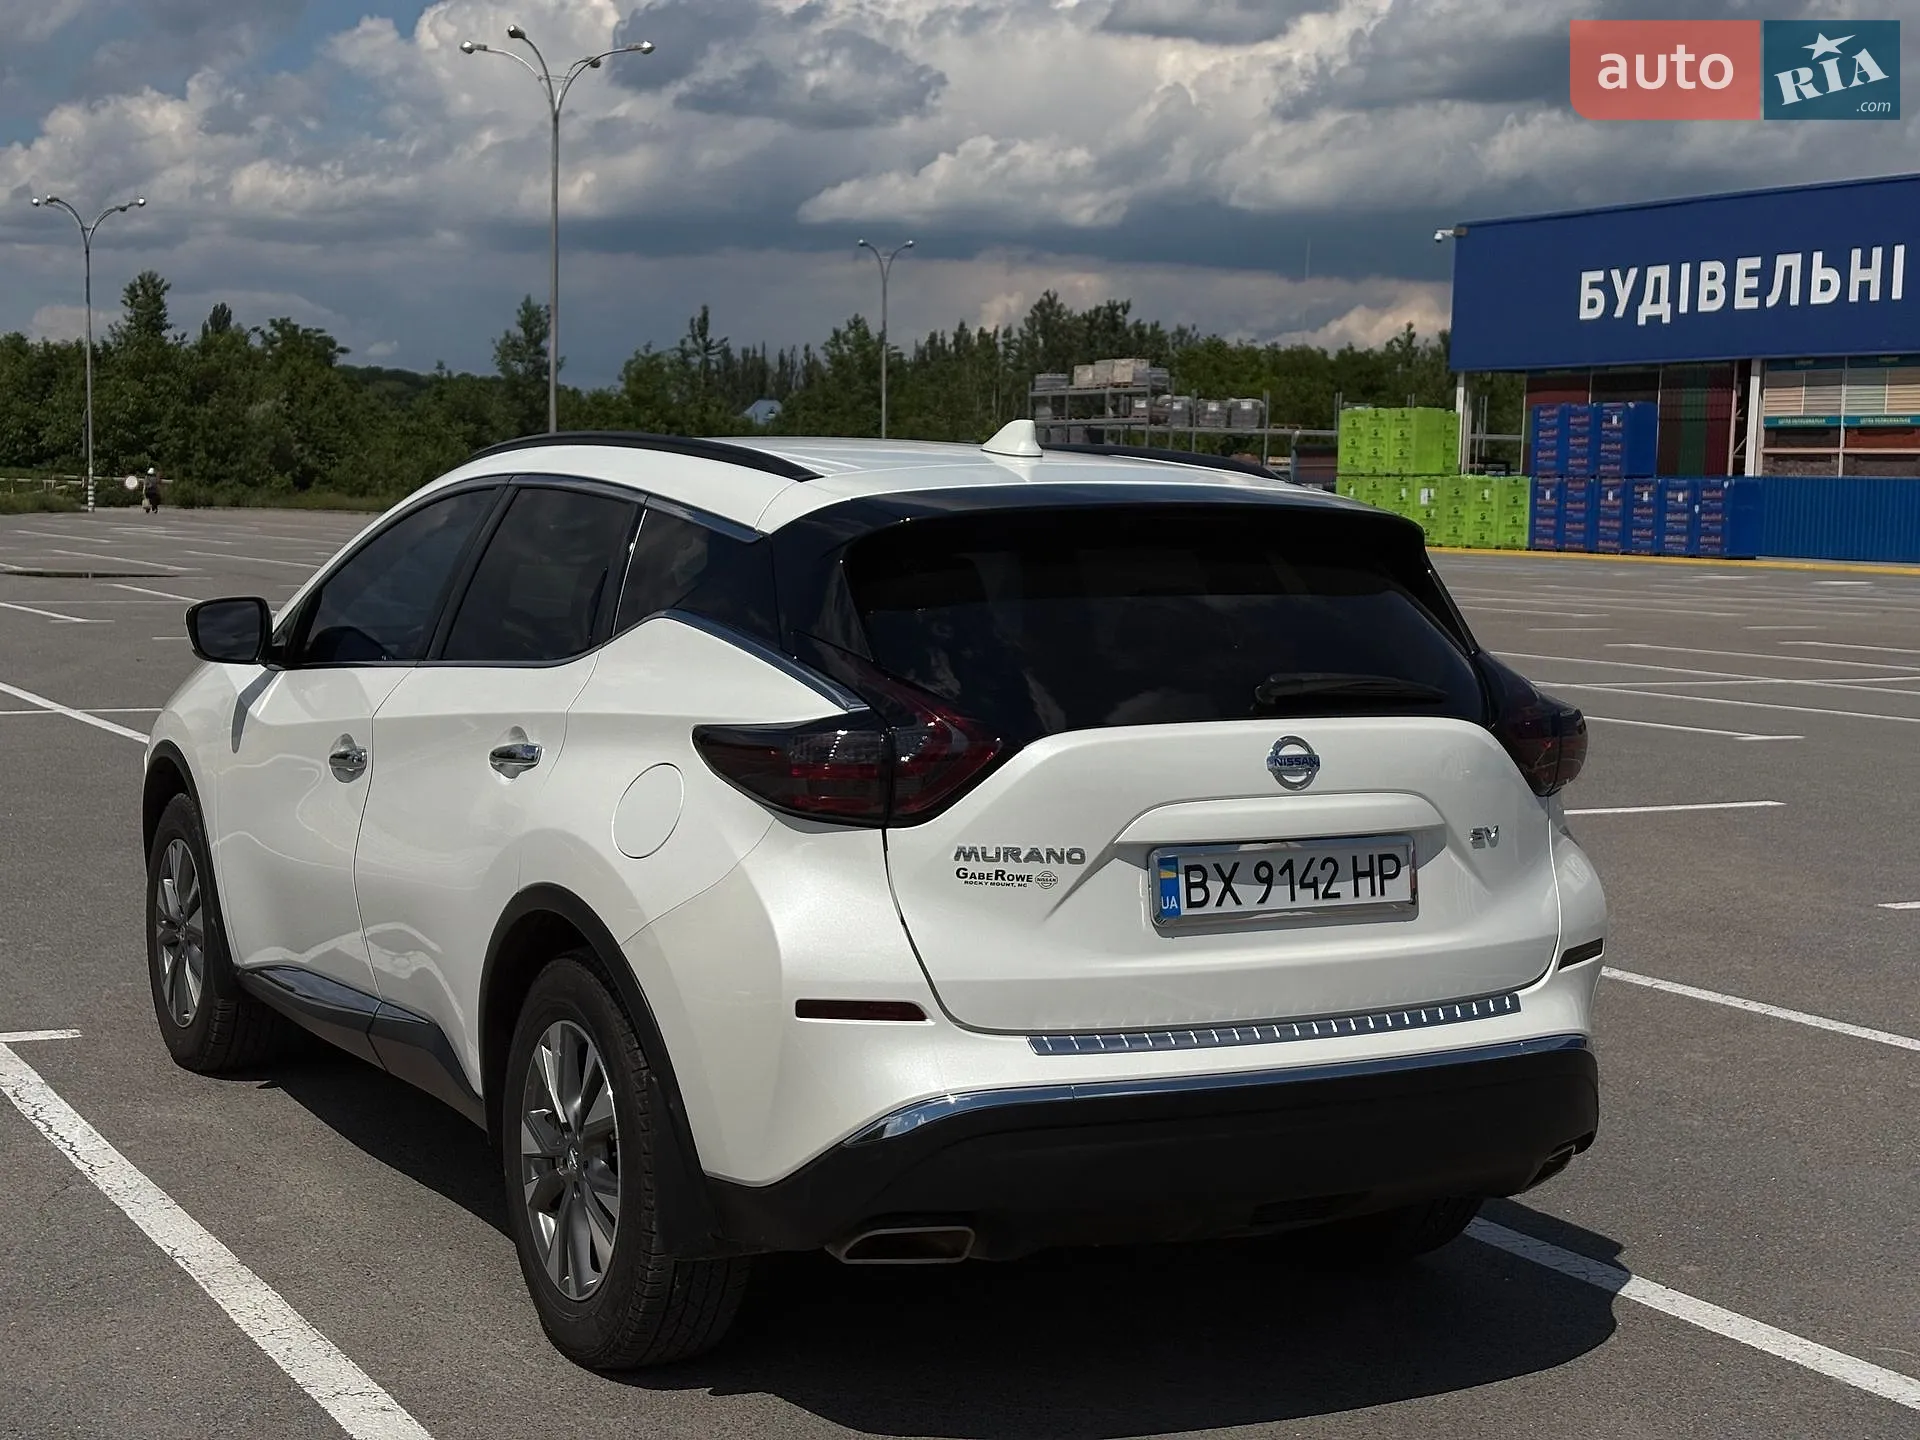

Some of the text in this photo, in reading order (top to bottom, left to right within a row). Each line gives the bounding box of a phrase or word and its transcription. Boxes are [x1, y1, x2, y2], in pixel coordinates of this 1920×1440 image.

[1578, 243, 1906, 326] БУДІВЕЛЬНІ
[1274, 755, 1319, 768] NISSAN
[953, 845, 1087, 865] MURANO
[1184, 853, 1402, 909] BX 9142 HP
[1161, 896, 1179, 909] UA
